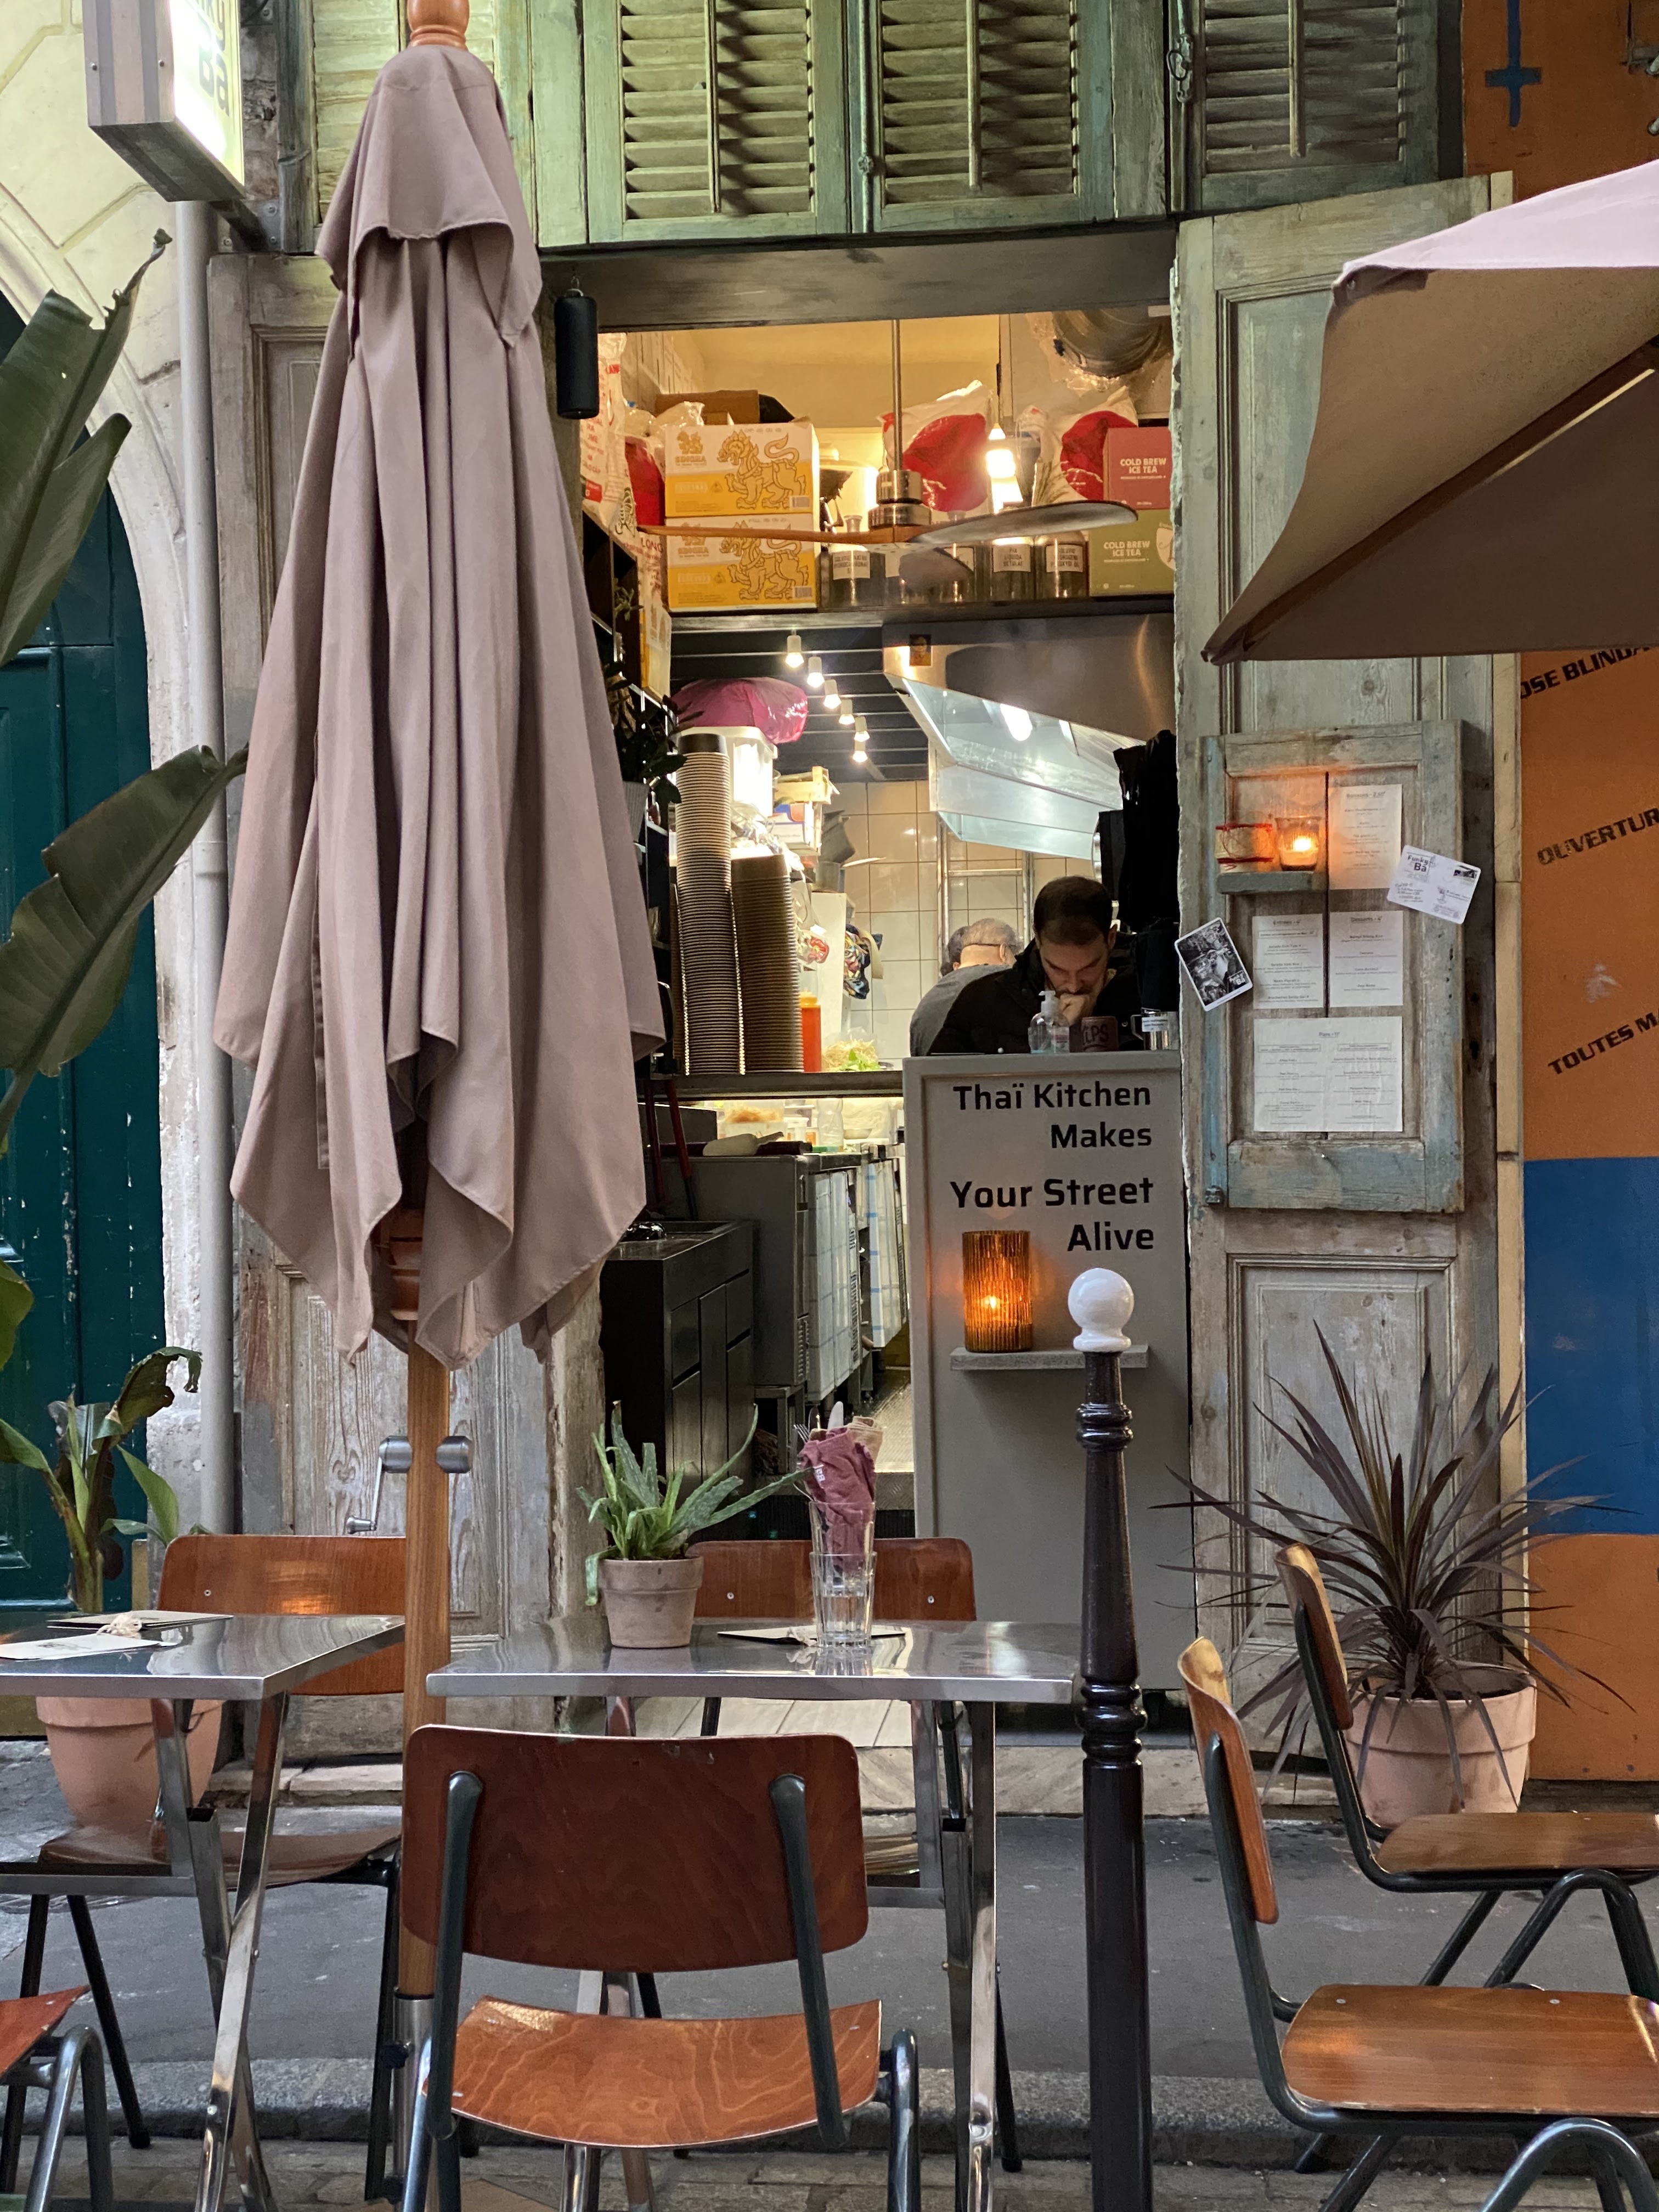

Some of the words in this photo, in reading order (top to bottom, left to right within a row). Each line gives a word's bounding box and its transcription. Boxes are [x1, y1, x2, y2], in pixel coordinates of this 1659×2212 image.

[1548, 1024, 1634, 1074] TOUTES
[953, 1083, 1024, 1110] Thaï
[1034, 1081, 1151, 1108] Kitchen
[1051, 1121, 1152, 1148] Makes
[950, 1181, 1032, 1208] Your
[1043, 1178, 1153, 1206] Street
[1067, 1221, 1154, 1252] Alive
